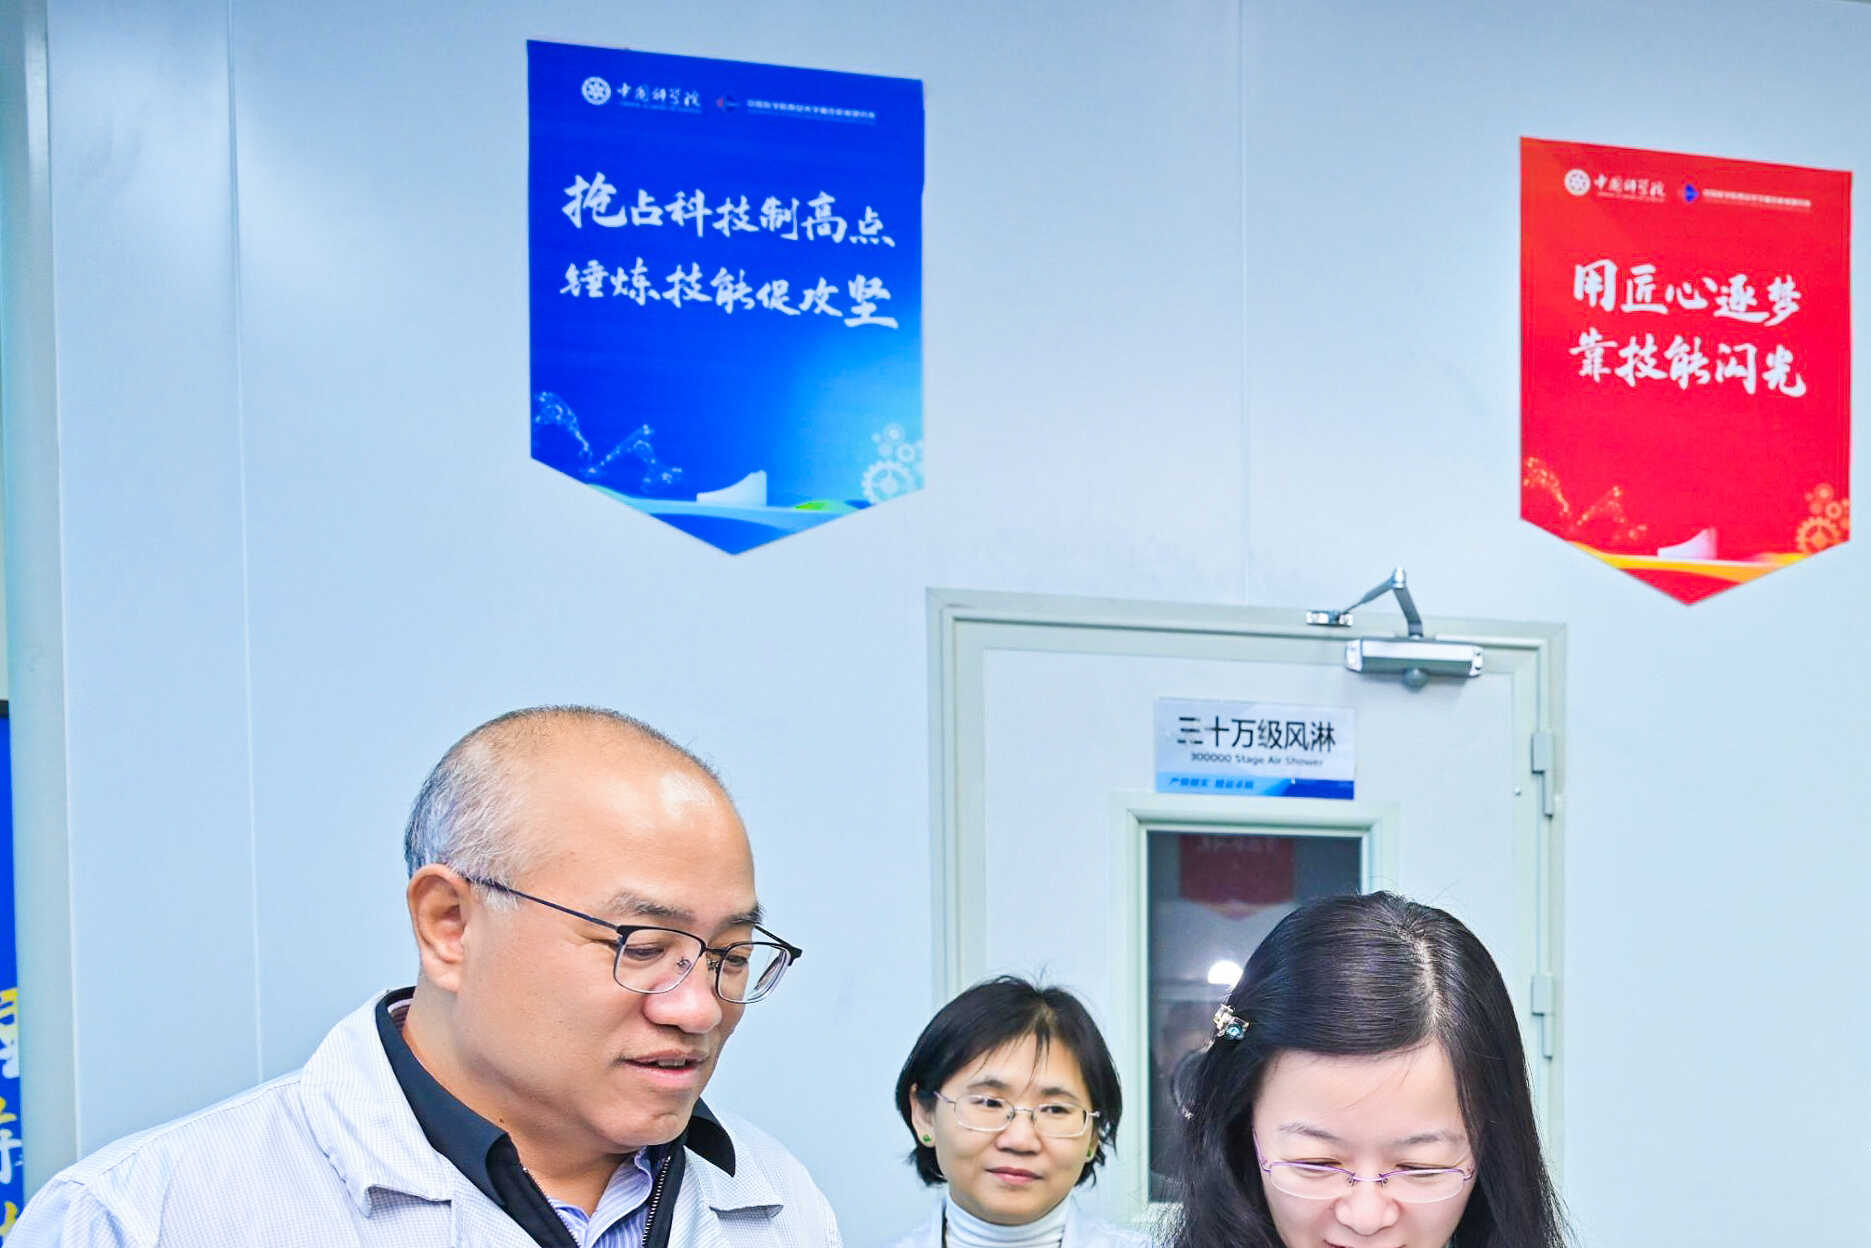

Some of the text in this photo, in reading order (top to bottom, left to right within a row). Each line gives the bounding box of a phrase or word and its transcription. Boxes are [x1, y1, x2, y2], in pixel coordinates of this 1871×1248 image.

[562, 172, 895, 247] 抢占科技制高点
[560, 257, 898, 328] 锤炼技能促攻坚
[1573, 259, 1802, 327] 用匠心逐梦
[1569, 327, 1807, 397] 靠技能闪光
[1177, 715, 1336, 753] 三十万级风淋
